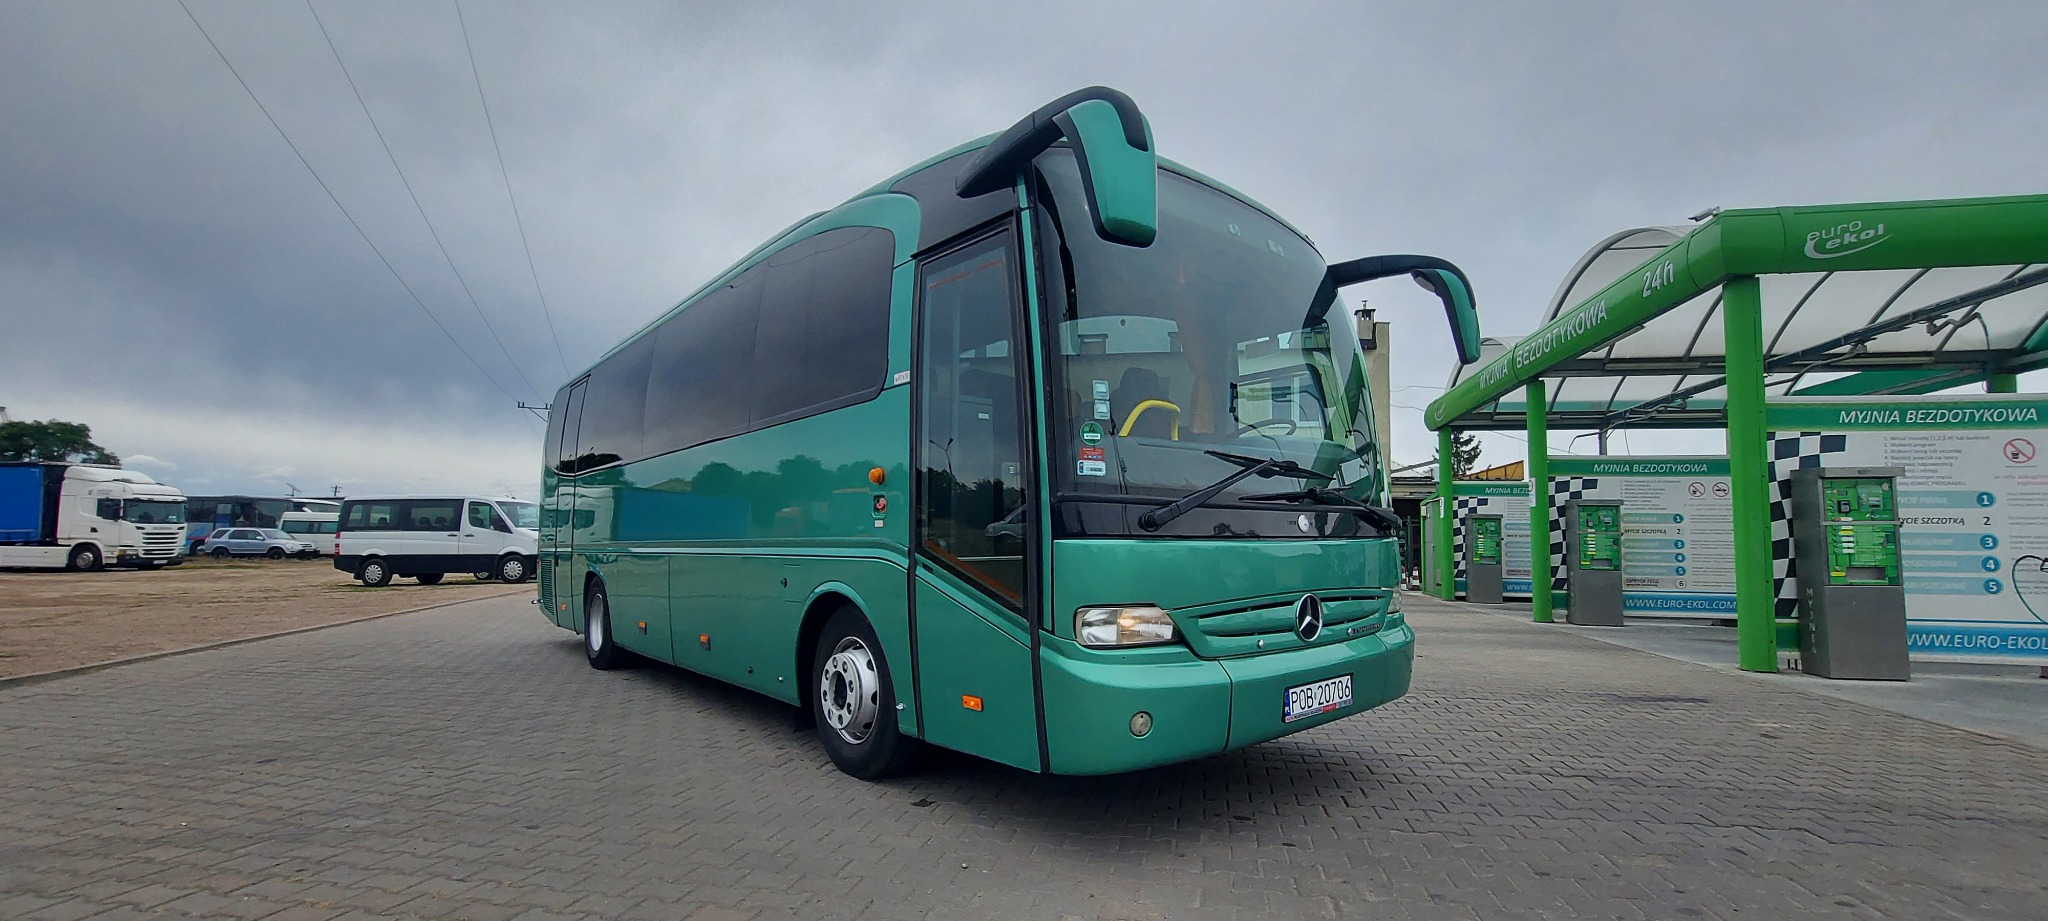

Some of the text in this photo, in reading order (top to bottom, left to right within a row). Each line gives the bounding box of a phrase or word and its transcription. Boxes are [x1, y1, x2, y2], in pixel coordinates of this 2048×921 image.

[1806, 220, 1862, 242] euro
[1825, 223, 1884, 249] ekol
[1479, 259, 1675, 390] MYJNIA BEZDOTYKOWA 24h
[1839, 408, 2038, 424] MYJNIA BEZDOTYKOWA
[1593, 463, 1708, 473] MYJNIA BEZDOTYKOWA
[1982, 495, 1990, 505] 1
[1899, 516, 1992, 526] YCIE SZCZOTKĄ 2
[1984, 537, 1994, 547] 3
[1986, 559, 1996, 570] 4
[1989, 581, 1997, 592] 5
[1625, 599, 1737, 609] WWW.EURO-EKOL.COM
[1806, 588, 1817, 655] MYJNIA
[1290, 687, 1314, 714] POB
[1317, 677, 1351, 706] 20706
